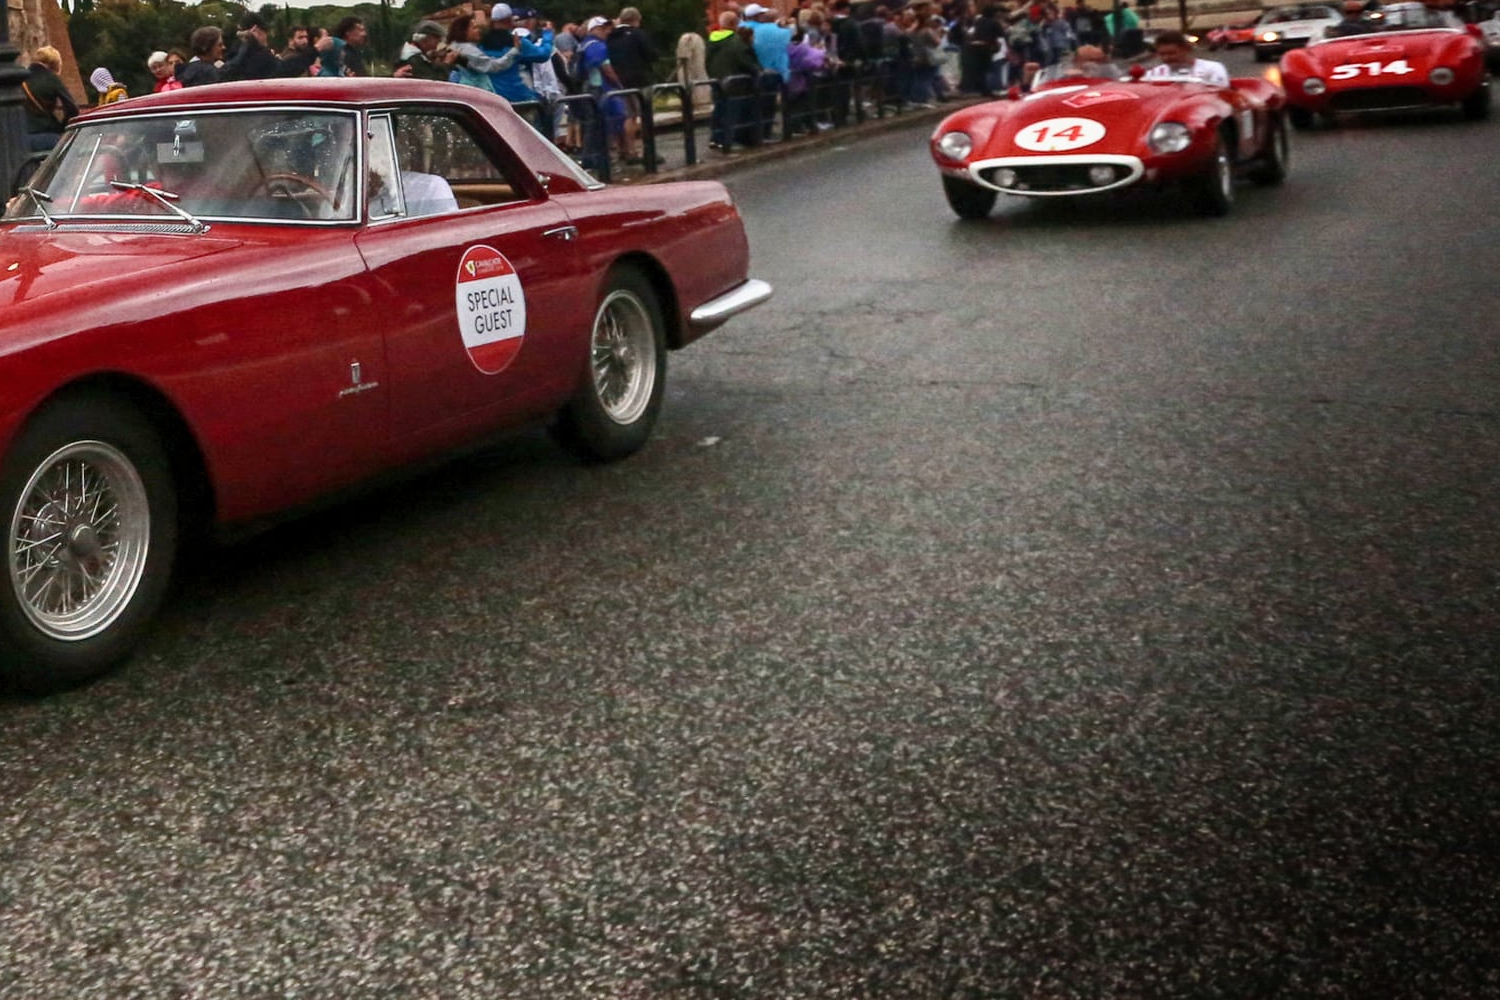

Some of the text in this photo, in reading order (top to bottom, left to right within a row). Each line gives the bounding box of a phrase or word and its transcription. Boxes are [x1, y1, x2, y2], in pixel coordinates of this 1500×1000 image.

[1329, 60, 1415, 79] 514
[1032, 125, 1085, 142] 14
[467, 286, 514, 312] SPECIAL
[475, 309, 512, 334] GUEST
